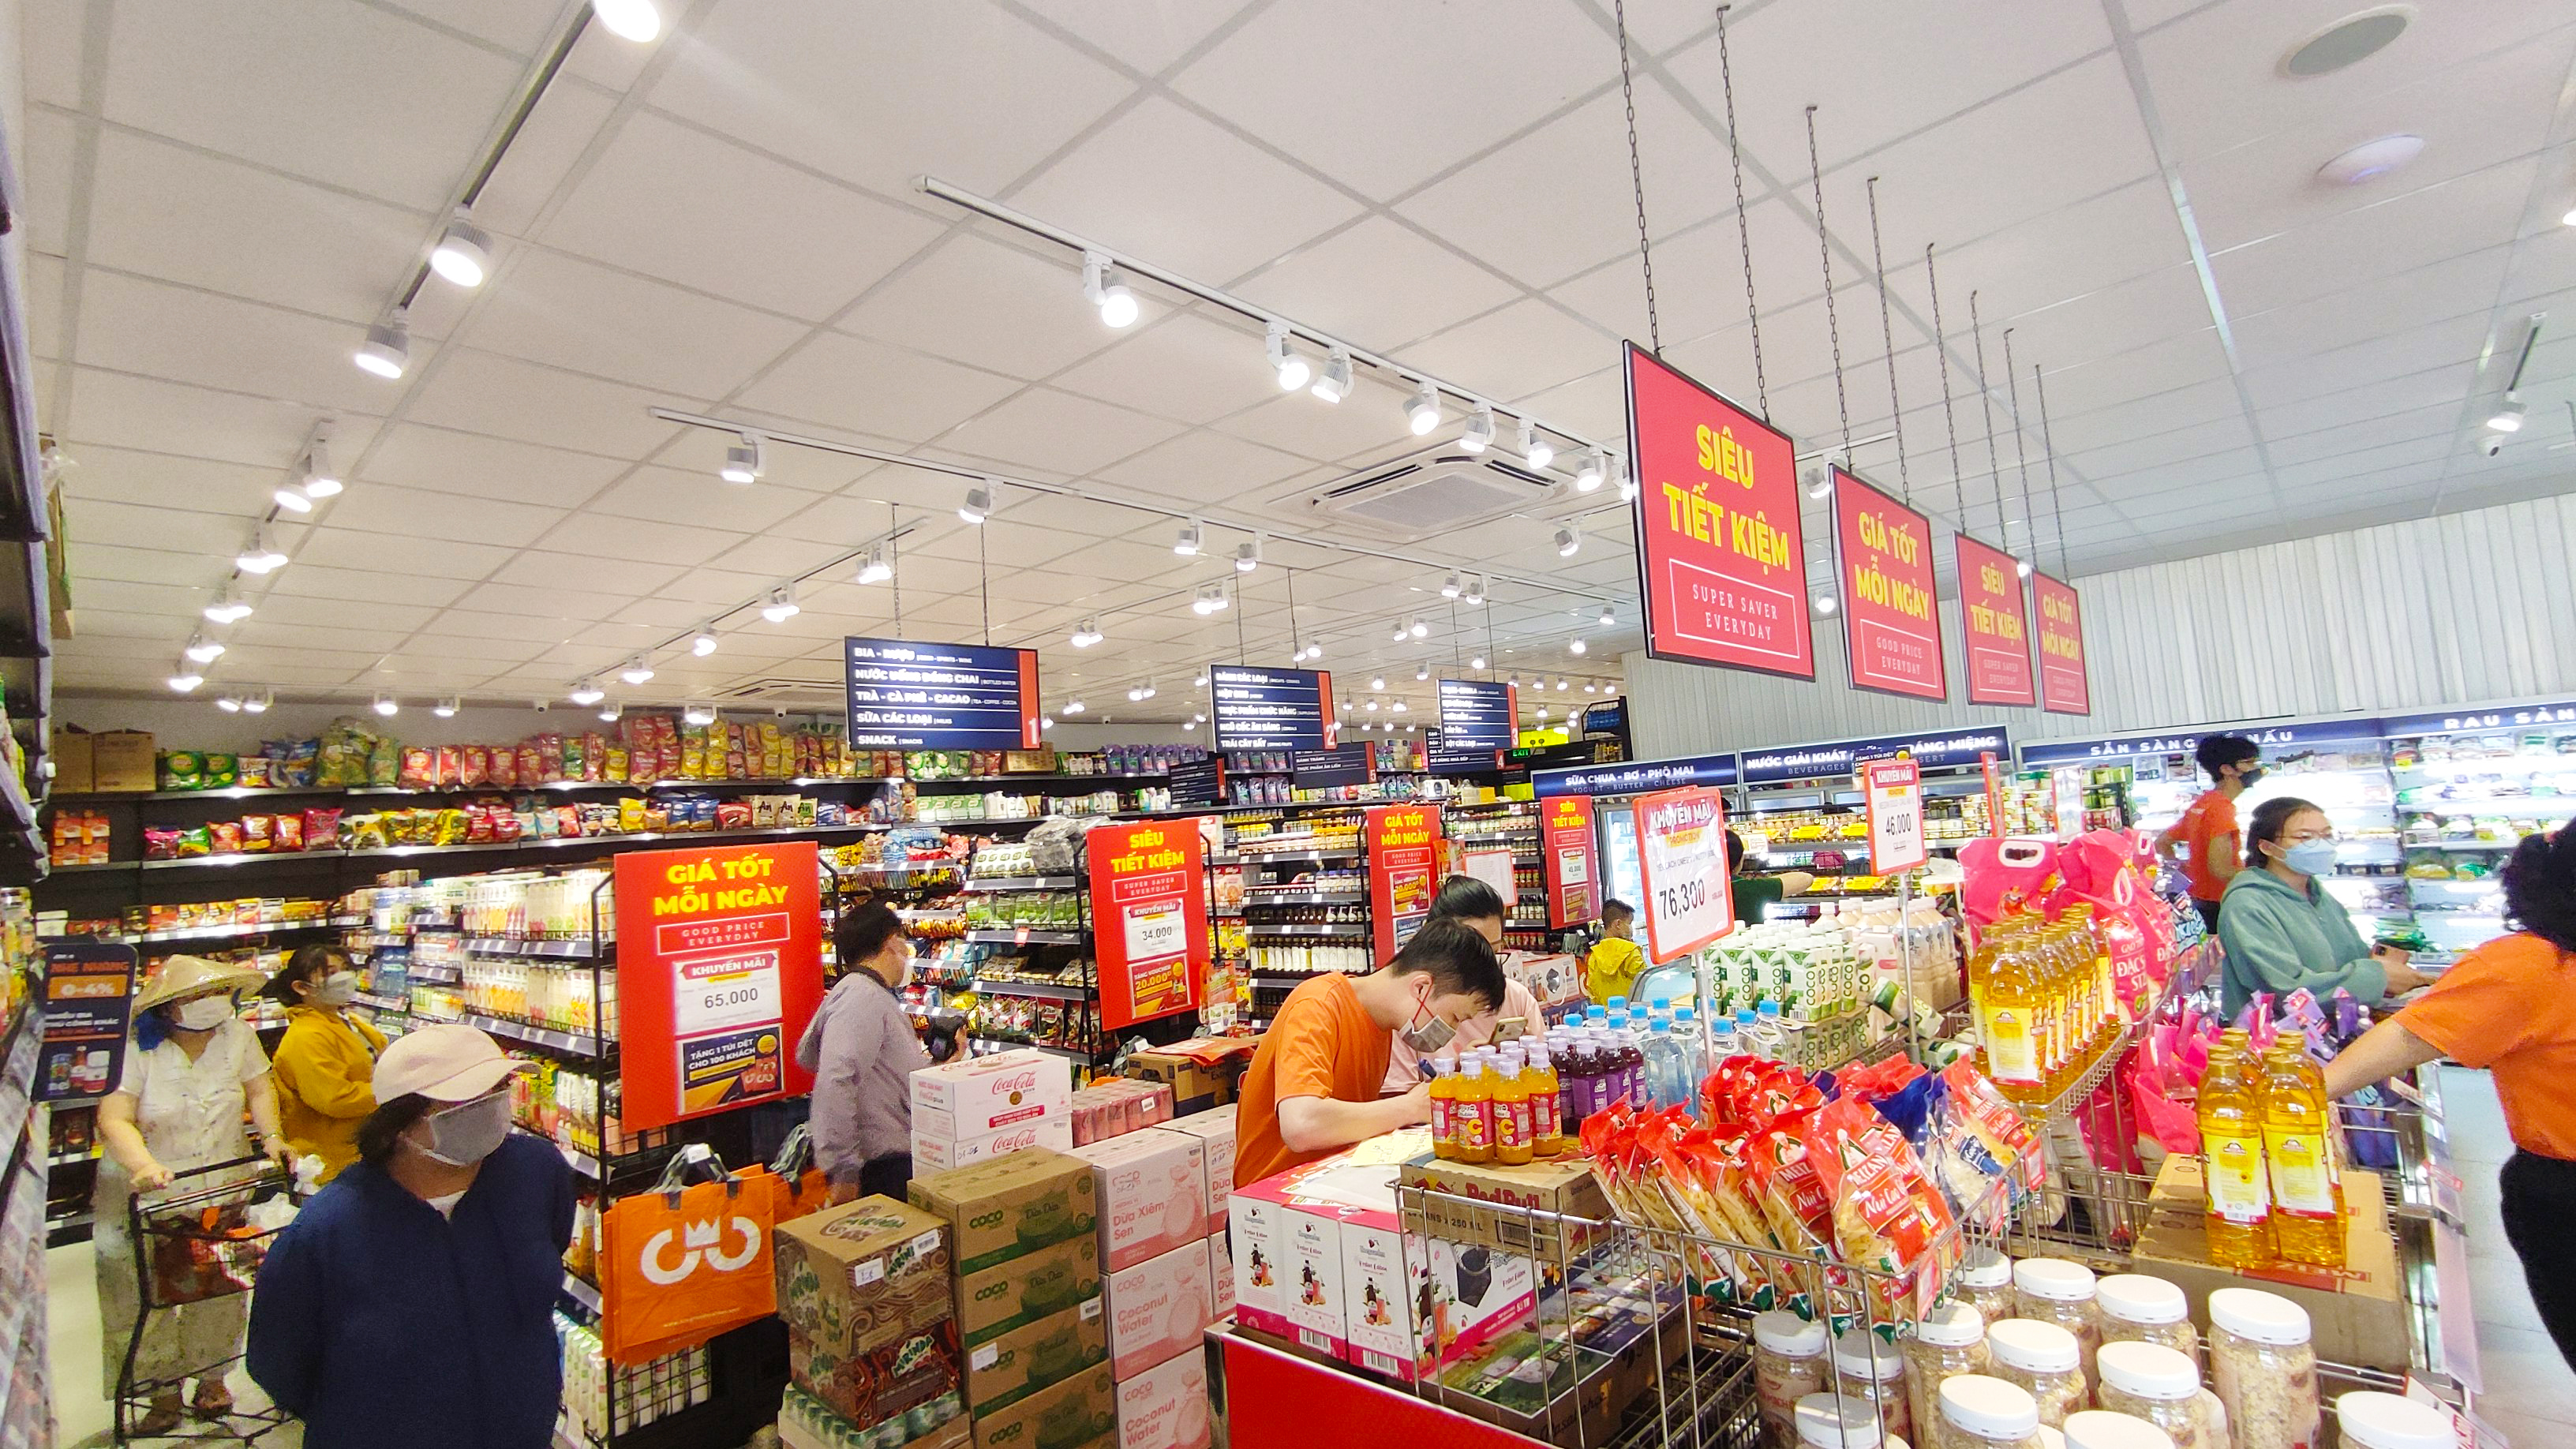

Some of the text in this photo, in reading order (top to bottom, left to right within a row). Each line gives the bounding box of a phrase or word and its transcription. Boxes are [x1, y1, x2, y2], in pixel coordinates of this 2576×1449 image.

[1696, 425, 1754, 489] SIÊU
[1662, 481, 1791, 575] TIẾT KIỆM
[1858, 511, 1918, 568] GIÁ TỐT
[1855, 554, 1929, 621] MỖI NGÀY
[1981, 562, 2005, 597] SIÊU
[1692, 583, 1778, 620] SUPER SAVER
[2042, 593, 2072, 624] GIÁ TỐT
[1705, 612, 1772, 641] EVERYDAY
[1970, 598, 2022, 646] TIẾT KIỆM
[855, 647, 875, 657] BIA
[1876, 636, 1923, 659] GOOD PRICE
[2042, 622, 2080, 661] MỖI NGÀY
[1881, 655, 1920, 675] EVERYDAY
[955, 675, 979, 683] CHAI
[856, 689, 880, 701] TRÀ
[934, 694, 970, 704] CACAO
[857, 711, 881, 723] SỮA
[882, 711, 905, 724] CÁC
[2444, 714, 2500, 729] RAU
[858, 735, 897, 745] SNACK
[1028, 717, 1038, 744] 1
[1325, 724, 1335, 746] 2
[1511, 727, 1518, 746] 3
[1747, 736, 1998, 769] NƯỚC GIẢI KHÁT MIỆNG
[2090, 741, 2129, 756] SẴN
[2140, 739, 2196, 752] SÀNG
[1497, 754, 1504, 767] 4
[1788, 763, 1845, 774] BEVERAGES
[1369, 769, 1376, 781] 5
[1566, 766, 1694, 786] SỮA CHUA BƠ PHÔ MAI
[1875, 766, 1913, 784] KHUYẾN MÃI
[1219, 784, 1226, 796] 6
[1573, 778, 1687, 794] YOGURT BUTTER CHEESE
[1559, 800, 1576, 813] SIÊU
[1385, 811, 1424, 827] GIÁ TỐT
[1552, 814, 1586, 828] TIẾT KIỆM
[1885, 813, 1911, 837] 46.000
[1129, 829, 1164, 848] SIÊU
[1381, 828, 1430, 846] MỖI NGÀY
[668, 853, 774, 884] GIÁ TỐT
[1110, 850, 1185, 873] TIẾT KIỆM
[1124, 880, 1148, 890] SUPER
[1130, 885, 1170, 896] EVERYDAY
[654, 882, 788, 915] MỖI NGÀY
[1659, 878, 1705, 921] 76,300
[682, 921, 765, 938] GOOD PRICE
[688, 931, 760, 946] EVERYDAY
[1142, 927, 1172, 941] 34.000
[691, 957, 766, 977] KHUYẾN MÃI
[704, 987, 758, 1009] 65.000
[688, 1046, 755, 1070] CHO 100 KHÁCH
[690, 1047, 715, 1061] TẶNG
[721, 1042, 736, 1052] TÚI
[737, 1038, 754, 1049] DỆT
[1466, 1182, 1540, 1211] Red Bull
[1113, 1201, 1165, 1227] Dừa Xiêm
[1866, 1197, 1884, 1218] Nui
[1114, 1226, 1133, 1241] Sen
[1451, 1218, 1467, 1229] 250
[886, 1245, 915, 1279] MIRIN
[1118, 1294, 1168, 1324] Coconut
[1119, 1312, 1154, 1335] Water
[892, 1334, 934, 1377] MIRINDA
[1125, 1397, 1175, 1432] Coconut
[1126, 1421, 1161, 1447] Water
